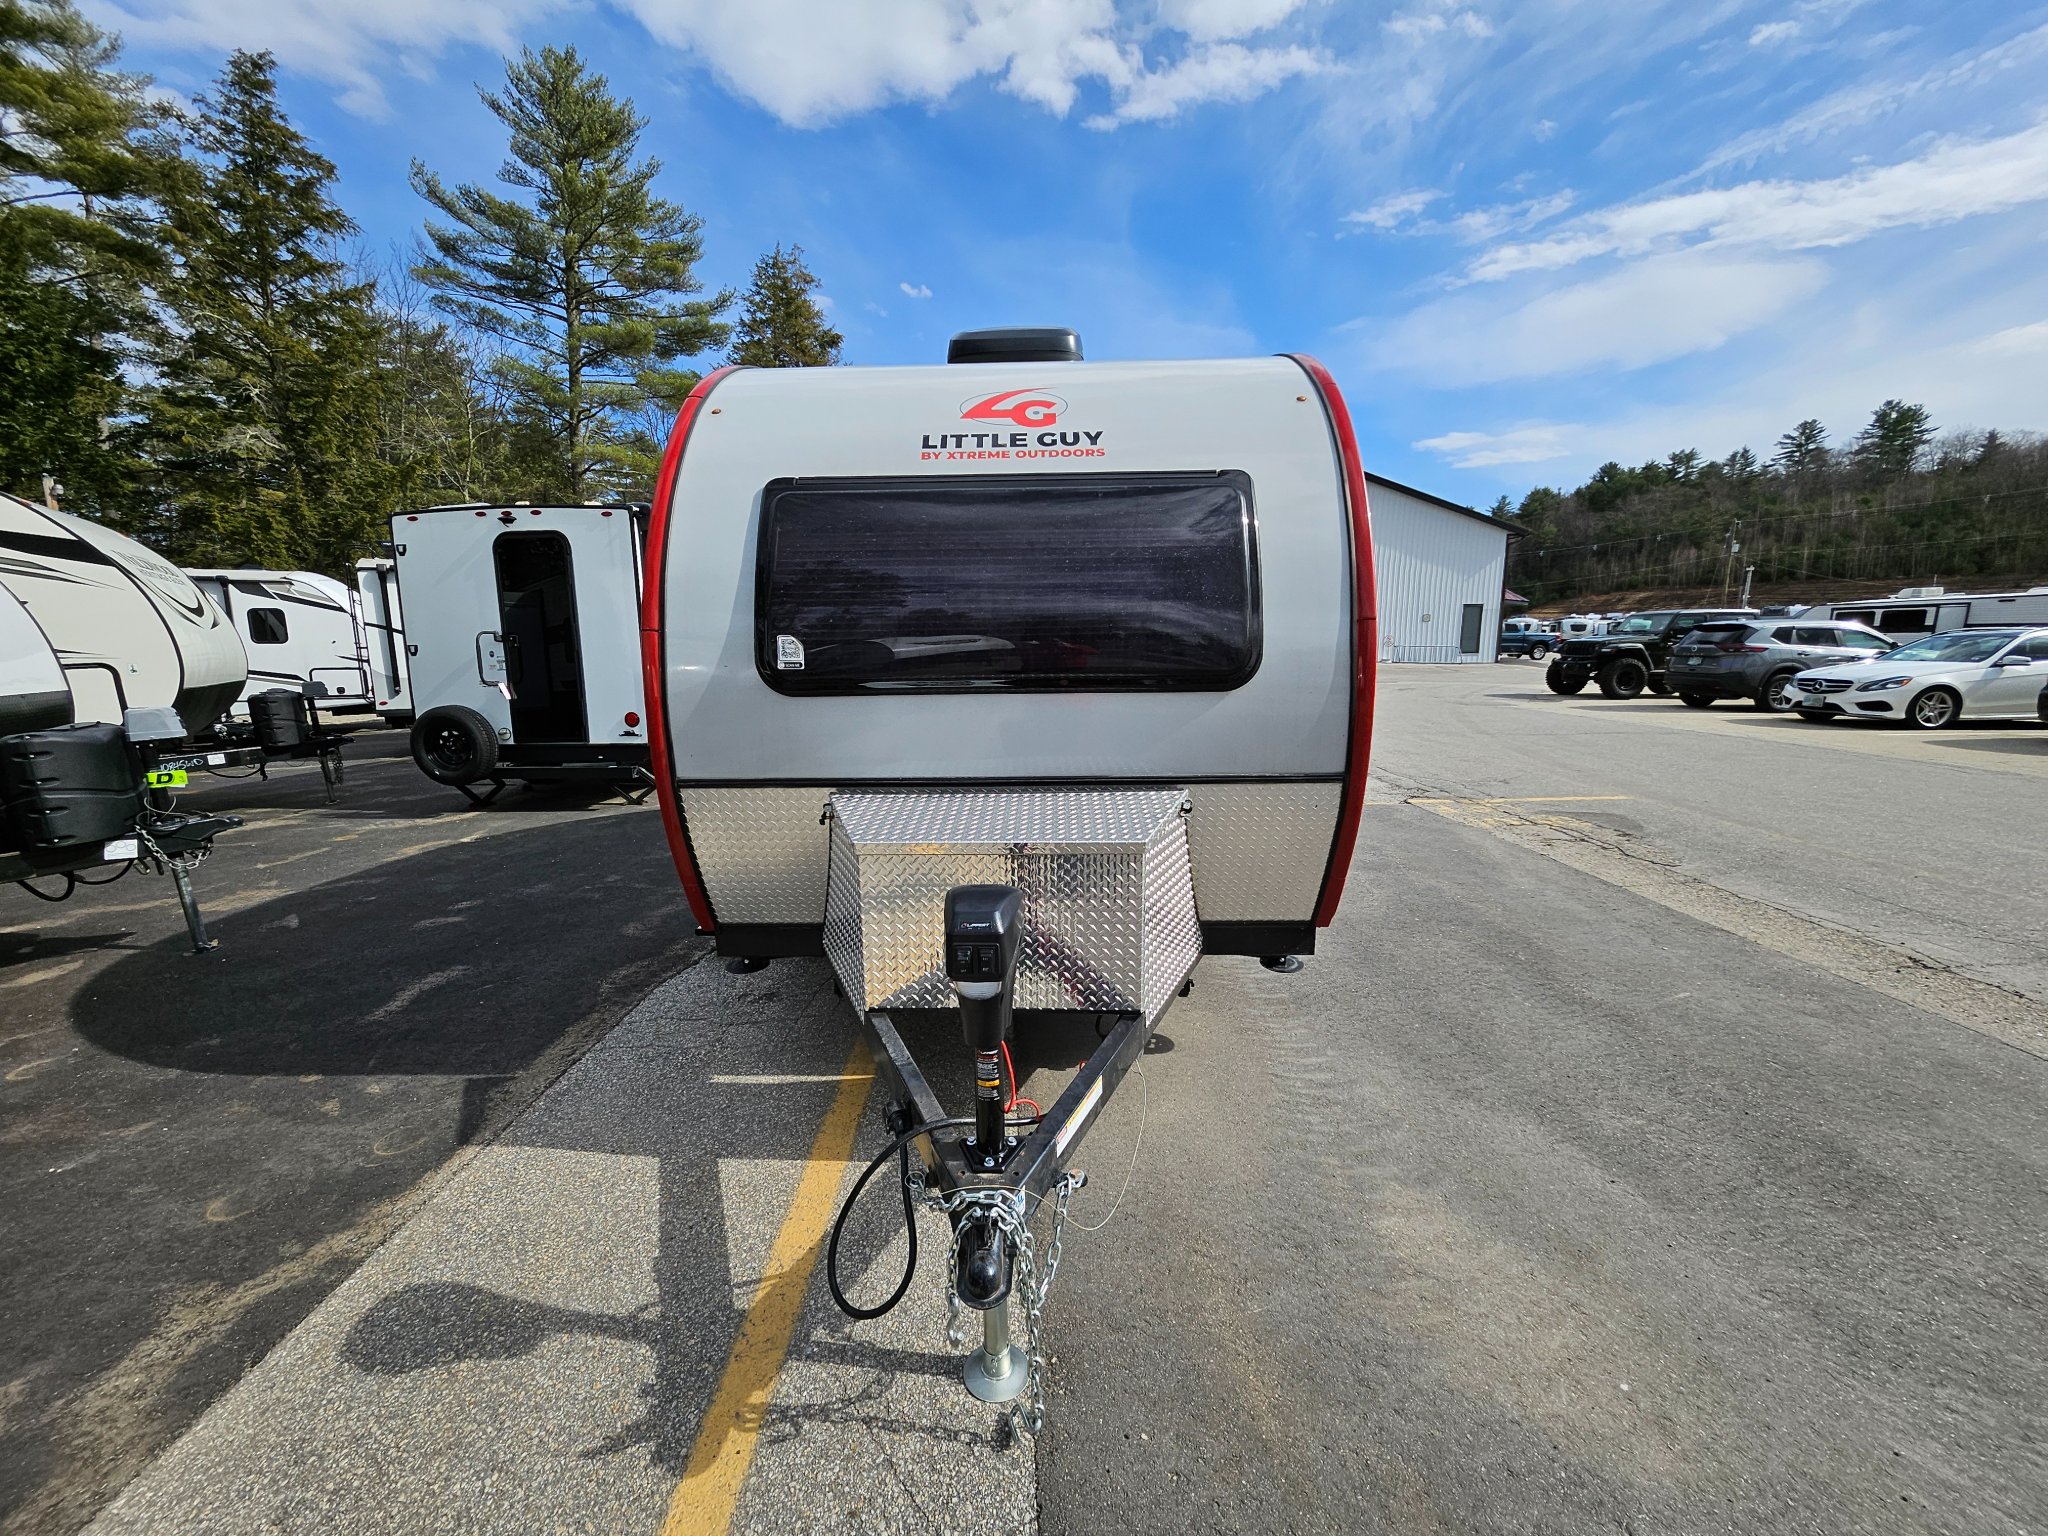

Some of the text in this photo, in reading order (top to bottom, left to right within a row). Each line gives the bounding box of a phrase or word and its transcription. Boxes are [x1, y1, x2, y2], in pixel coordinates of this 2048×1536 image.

[921, 430, 1104, 450] LITTLE GUY
[920, 448, 1106, 461] BY XTREME OUTDOORS
